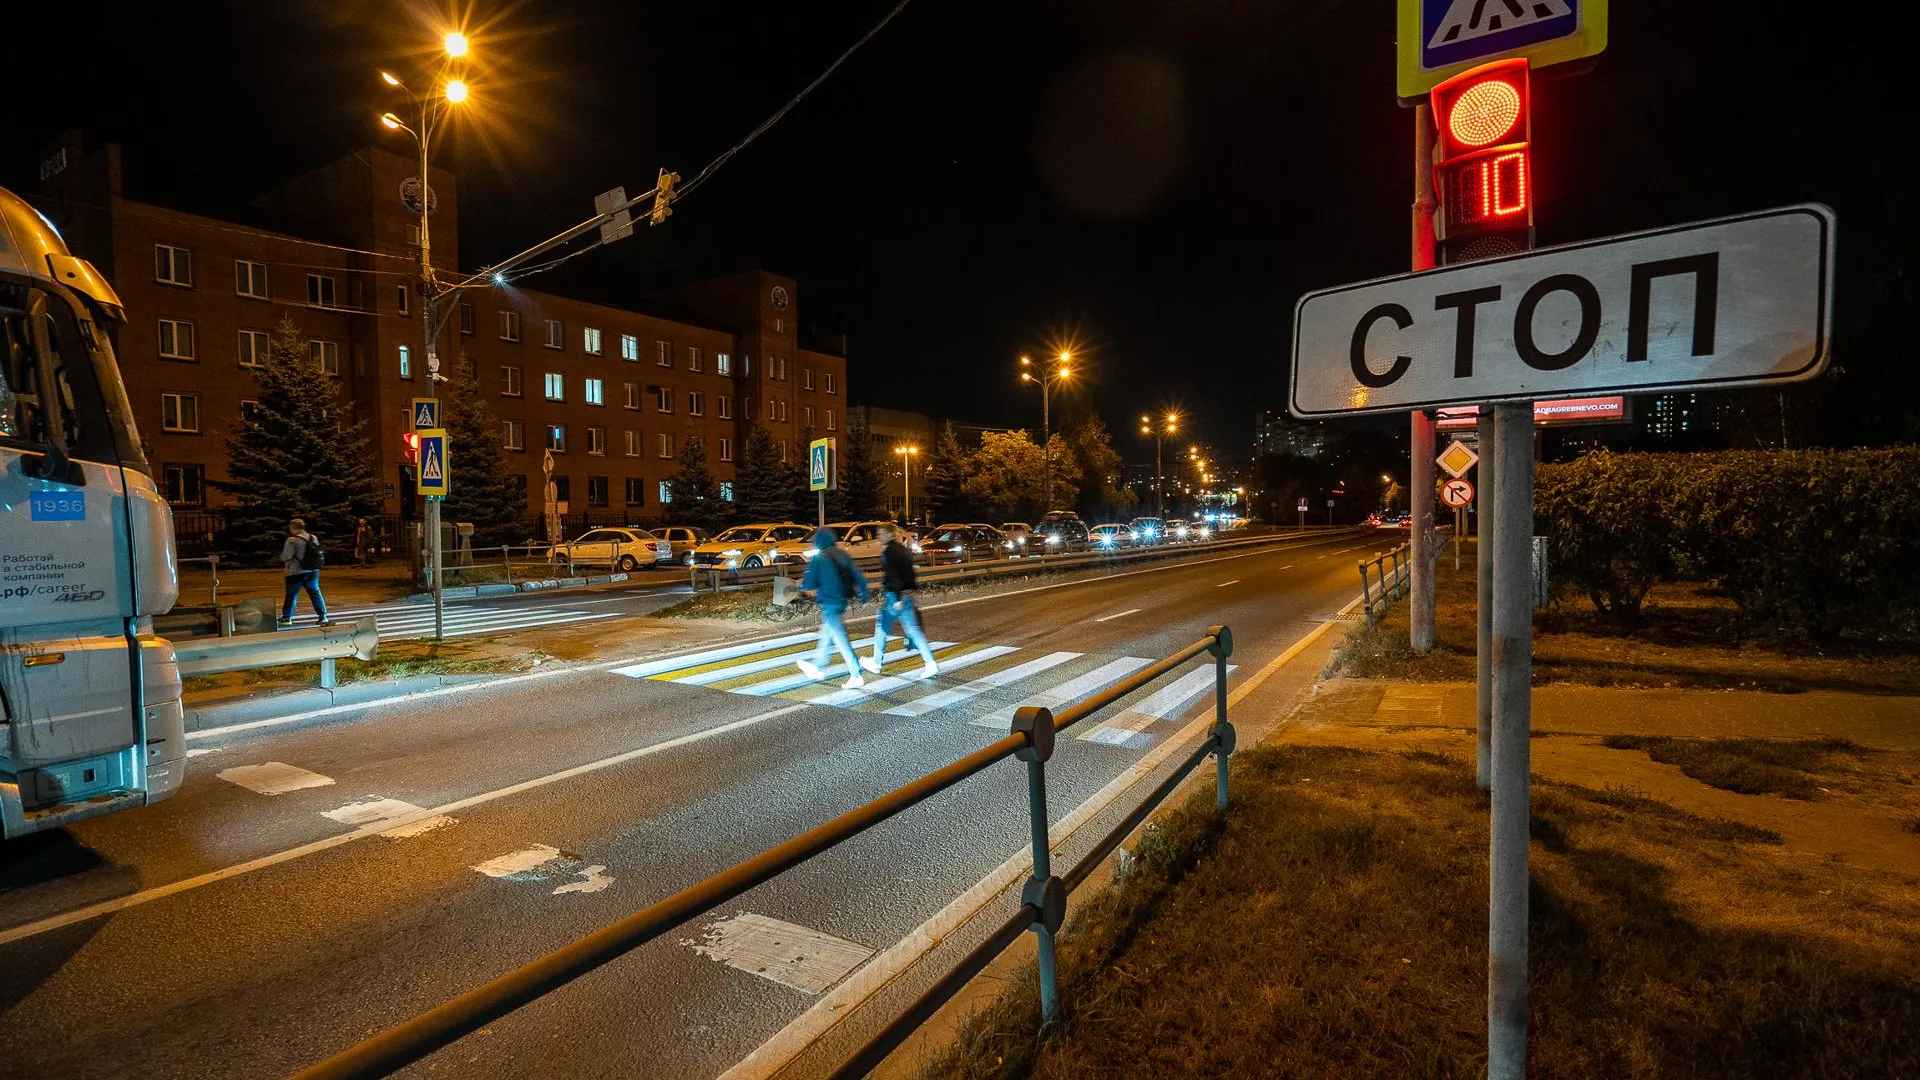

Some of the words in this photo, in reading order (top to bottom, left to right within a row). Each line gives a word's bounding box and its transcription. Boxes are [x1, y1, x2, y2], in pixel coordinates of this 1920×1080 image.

[1482, 153, 1525, 216] 10
[1349, 251, 1719, 389] СТОП
[33, 500, 83, 513] 1936
[3, 553, 54, 563] Работай
[14, 561, 85, 573] стабильной
[4, 572, 64, 582] компании
[54, 589, 105, 603] 460
